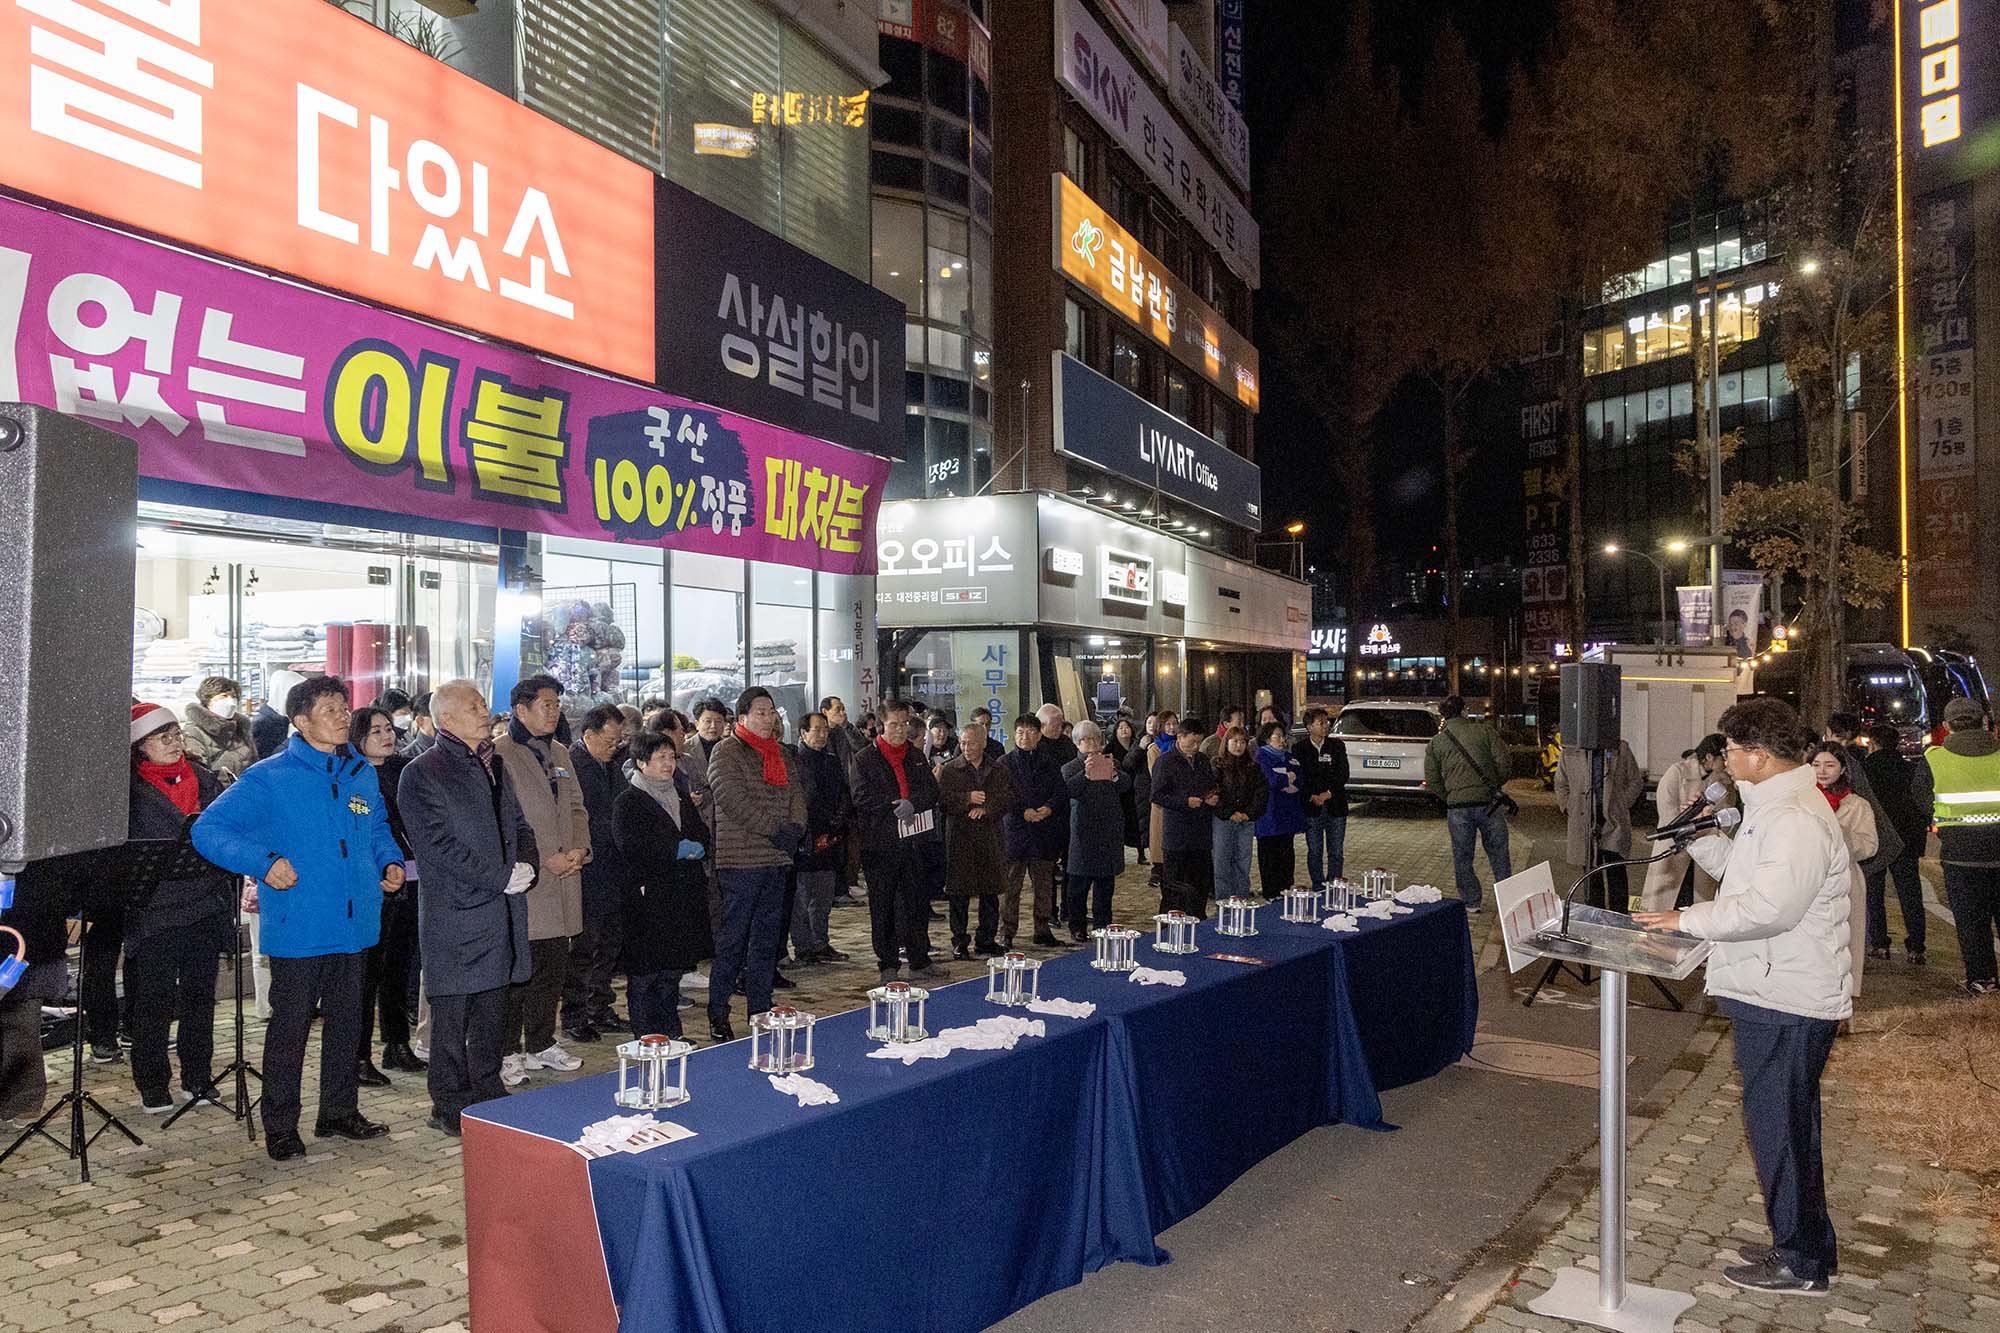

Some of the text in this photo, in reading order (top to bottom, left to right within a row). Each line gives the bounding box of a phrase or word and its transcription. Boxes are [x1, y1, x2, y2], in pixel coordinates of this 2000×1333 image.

[296, 81, 574, 320] 다있소
[1109, 239, 1178, 333] 금남관광
[717, 272, 880, 423] 상설할인
[47, 272, 308, 458] 없는
[326, 338, 575, 514] 이불
[1521, 402, 1558, 439] FIRST
[644, 406, 708, 463] 국산
[1140, 422, 1195, 483] LIVART
[1929, 441, 1966, 459] 75평
[593, 457, 748, 537] 100% 정품
[764, 456, 869, 553] 대처분
[878, 535, 1014, 577] 오오피스
[854, 600, 864, 661] 건물뒤
